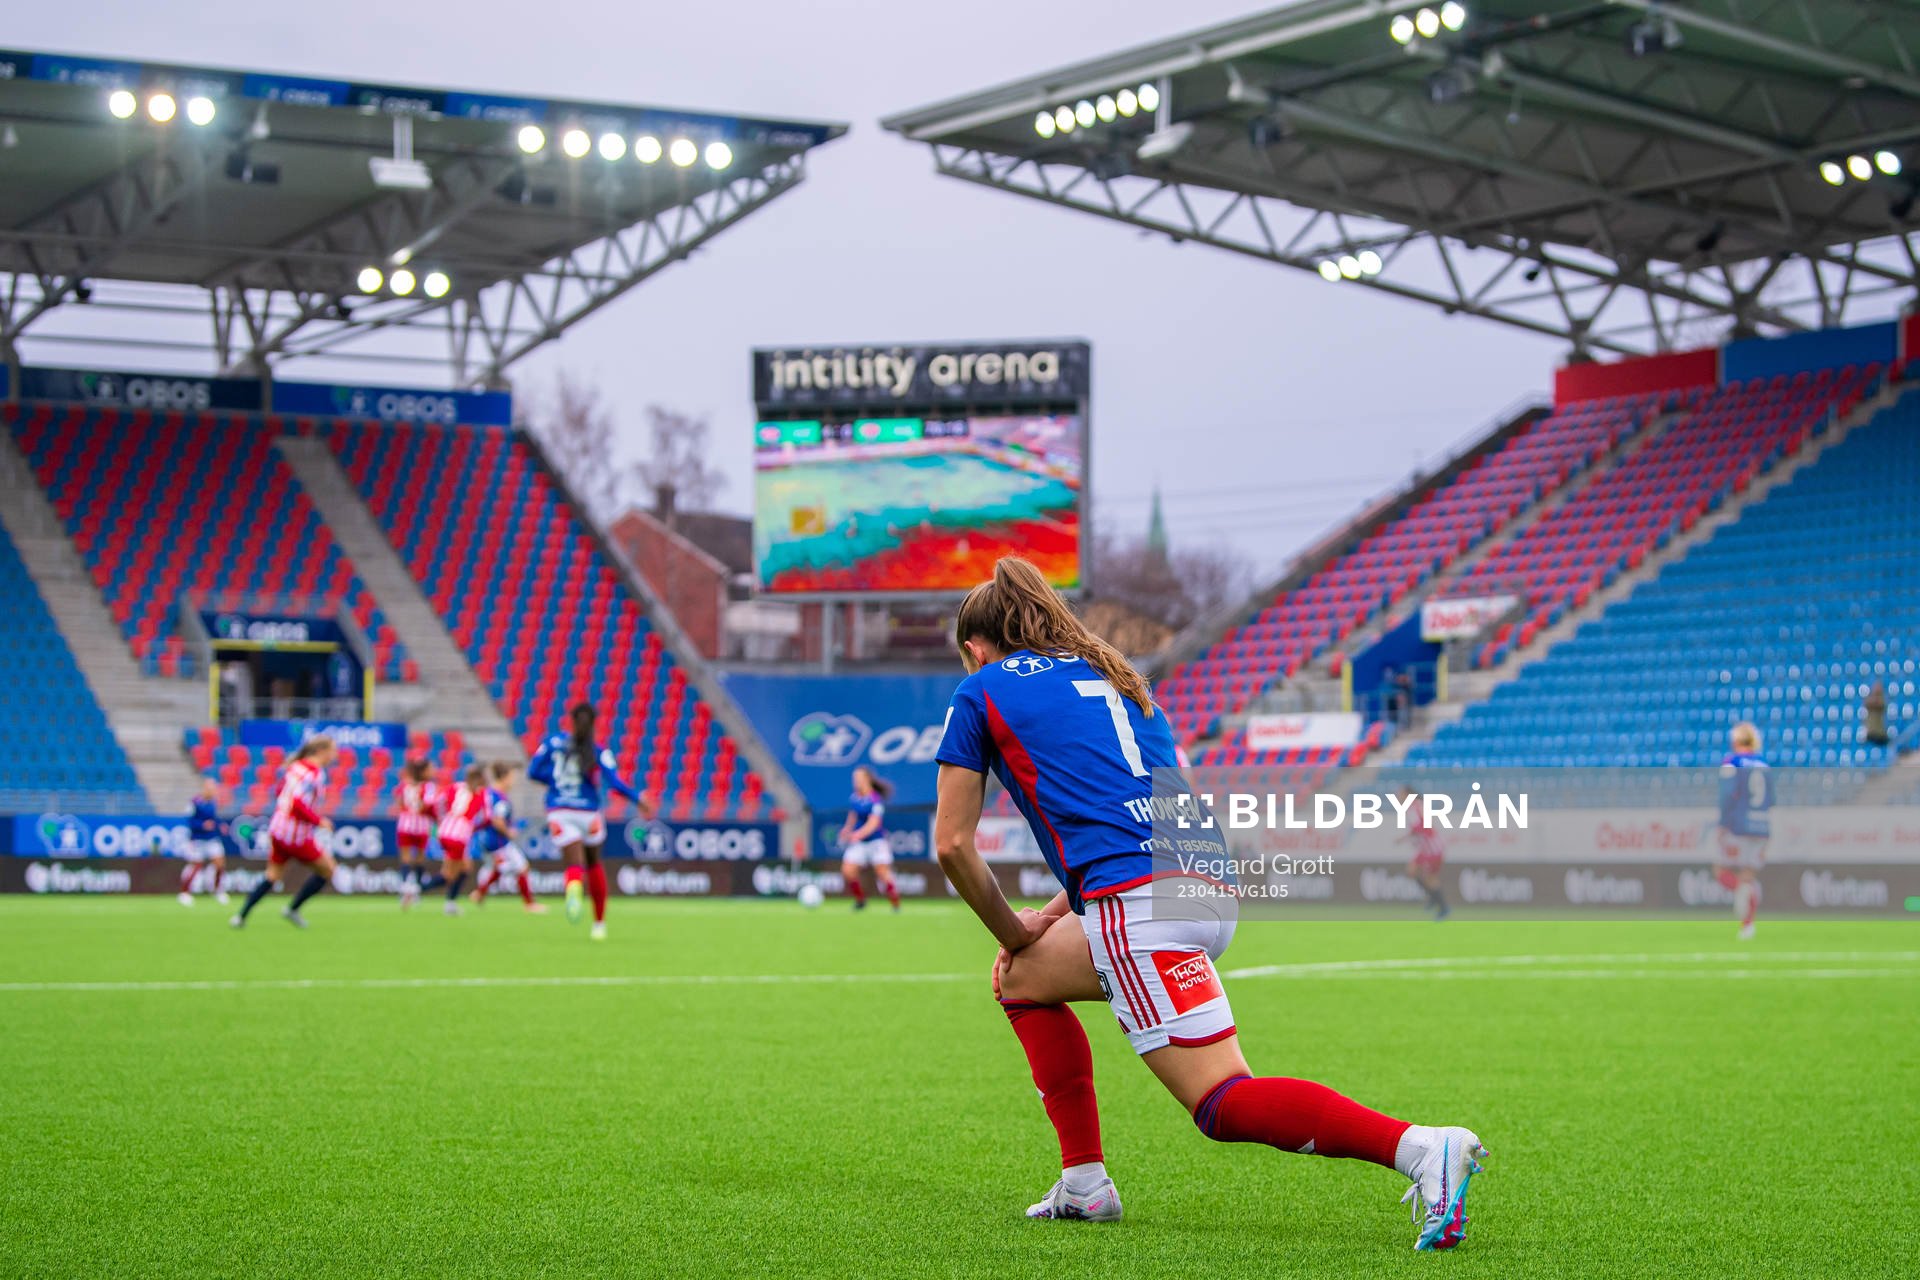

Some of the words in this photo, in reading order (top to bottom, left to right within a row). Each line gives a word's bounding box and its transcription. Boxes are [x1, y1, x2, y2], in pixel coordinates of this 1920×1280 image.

[771, 349, 916, 396] intility
[929, 352, 1059, 386] arena
[126, 378, 210, 409] OBOS
[378, 393, 457, 424] OBOS
[868, 725, 944, 765] OB
[1071, 680, 1151, 777] 7
[93, 825, 191, 858] OBOS
[676, 828, 765, 861] OBOS
[1166, 956, 1205, 982] THON
[1178, 972, 1210, 992] HOTELS
